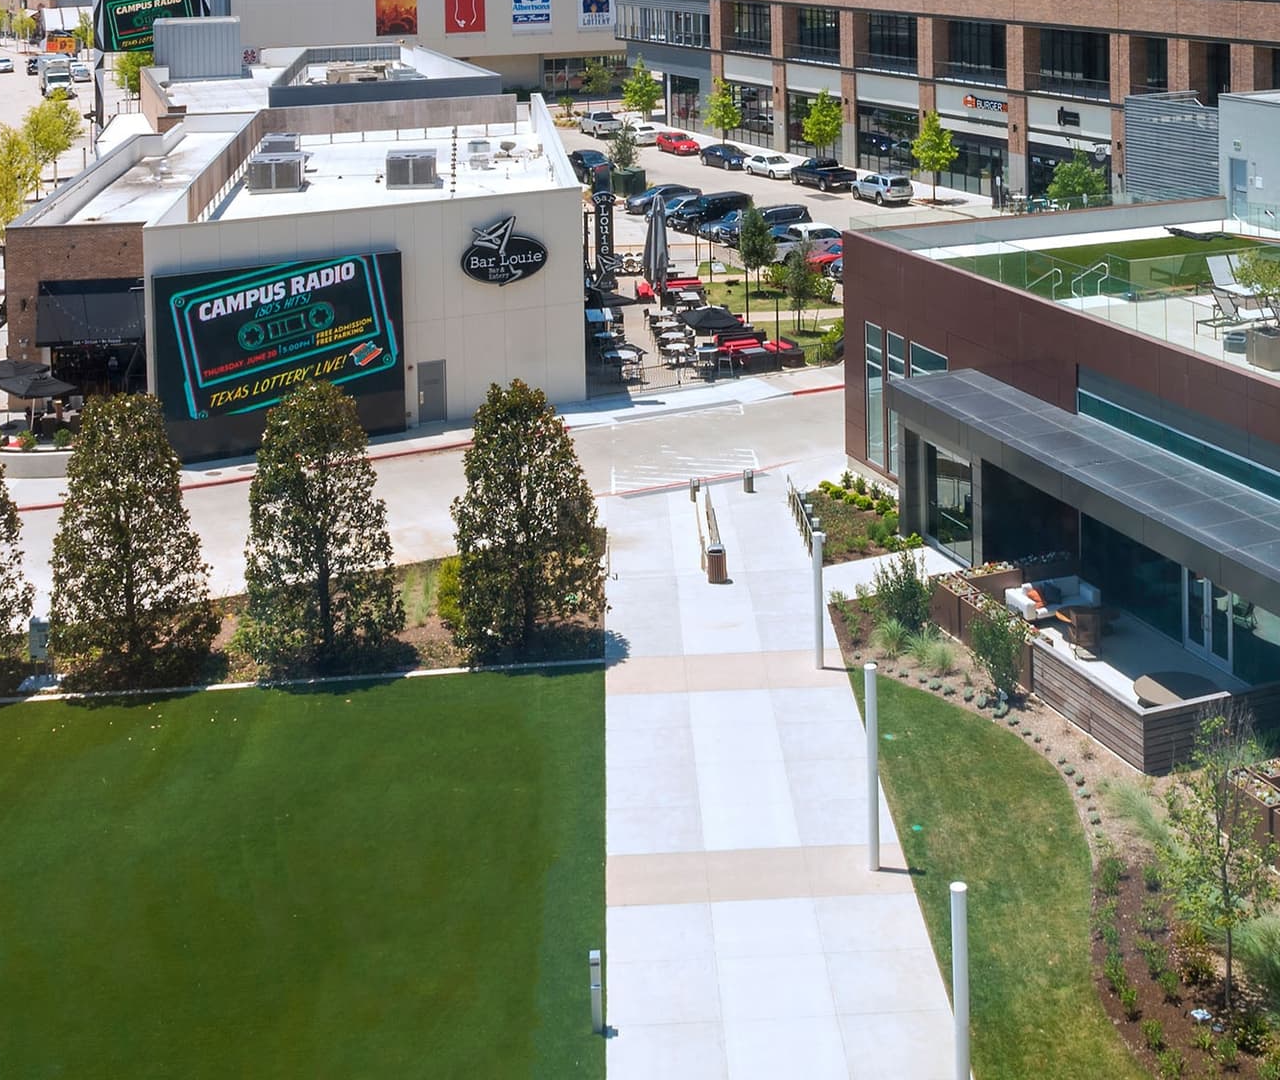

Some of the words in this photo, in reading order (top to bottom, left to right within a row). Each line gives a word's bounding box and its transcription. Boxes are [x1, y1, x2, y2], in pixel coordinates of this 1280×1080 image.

[116, 0, 153, 15] CAMPUS
[582, 17, 610, 26] LOTTERY
[593, 194, 614, 205] Bar
[599, 205, 609, 254] Louie
[470, 256, 496, 269] Bar
[198, 281, 286, 321] CAMPUS
[290, 261, 356, 296] RADIO
[284, 293, 312, 311] HITS)
[316, 328, 333, 339] FREE
[333, 316, 373, 333] ADMISSION
[316, 335, 333, 346] FREE
[333, 326, 365, 340] PARKING
[246, 353, 267, 365] JUNE
[267, 349, 277, 358] 20
[210, 385, 250, 408] TEXAS
[314, 354, 348, 377] LIVE!
